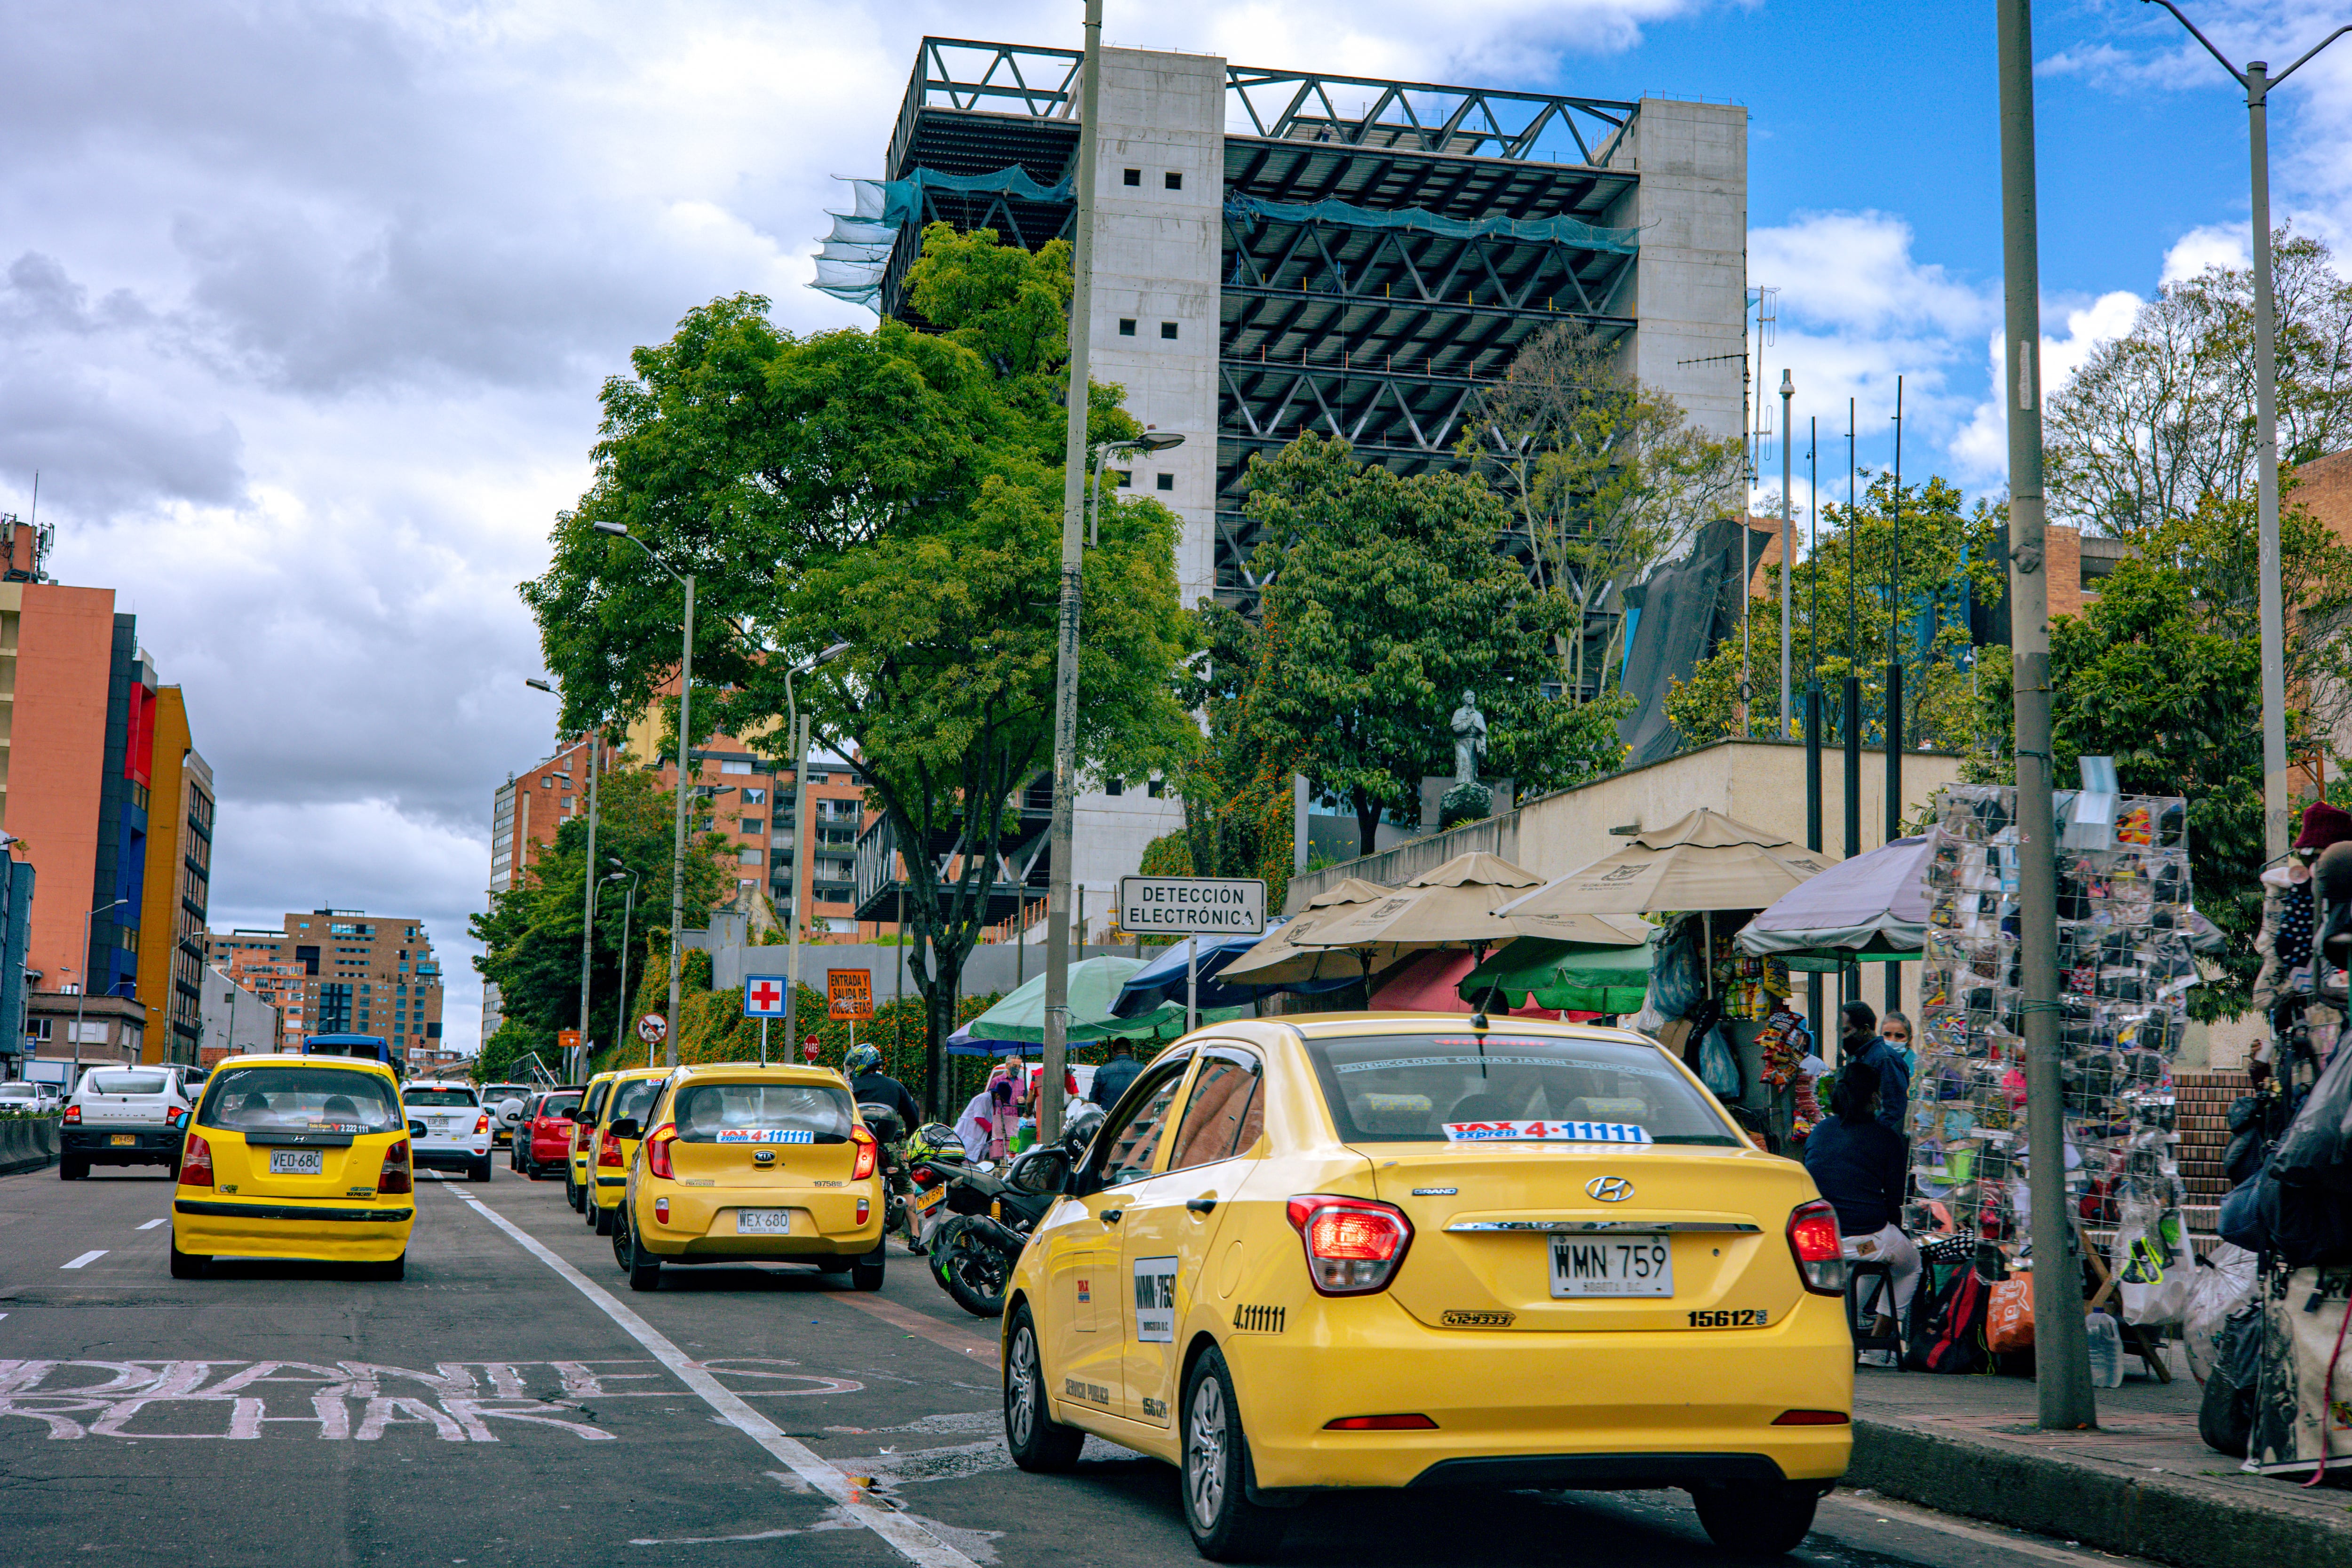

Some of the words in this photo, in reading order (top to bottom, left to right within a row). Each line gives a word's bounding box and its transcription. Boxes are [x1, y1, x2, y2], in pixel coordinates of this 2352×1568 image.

[1143, 885, 1244, 904] DETECCIÓN
[1130, 907, 1254, 925] ELECTRÓNICA
[831, 974, 862, 987] ENTRADA
[863, 975, 868, 987] Y
[833, 988, 857, 1000] SALIDA
[858, 988, 867, 1000] DE
[804, 1042, 818, 1053] PARE
[358, 1124, 369, 1133] 111
[1455, 1130, 1518, 1140] express
[739, 1213, 762, 1227] WEX
[765, 1213, 787, 1227] 680
[1554, 1245, 1607, 1278] WMN
[1616, 1245, 1666, 1278] 759
[1158, 1274, 1176, 1308] 759
[1143, 1321, 1160, 1331] BOGOTA
[1687, 1309, 1755, 1328] 15612
[1065, 1377, 1086, 1400] SERVICIO
[1087, 1383, 1109, 1406] PUBLICO
[1143, 1397, 1164, 1419] 15612
